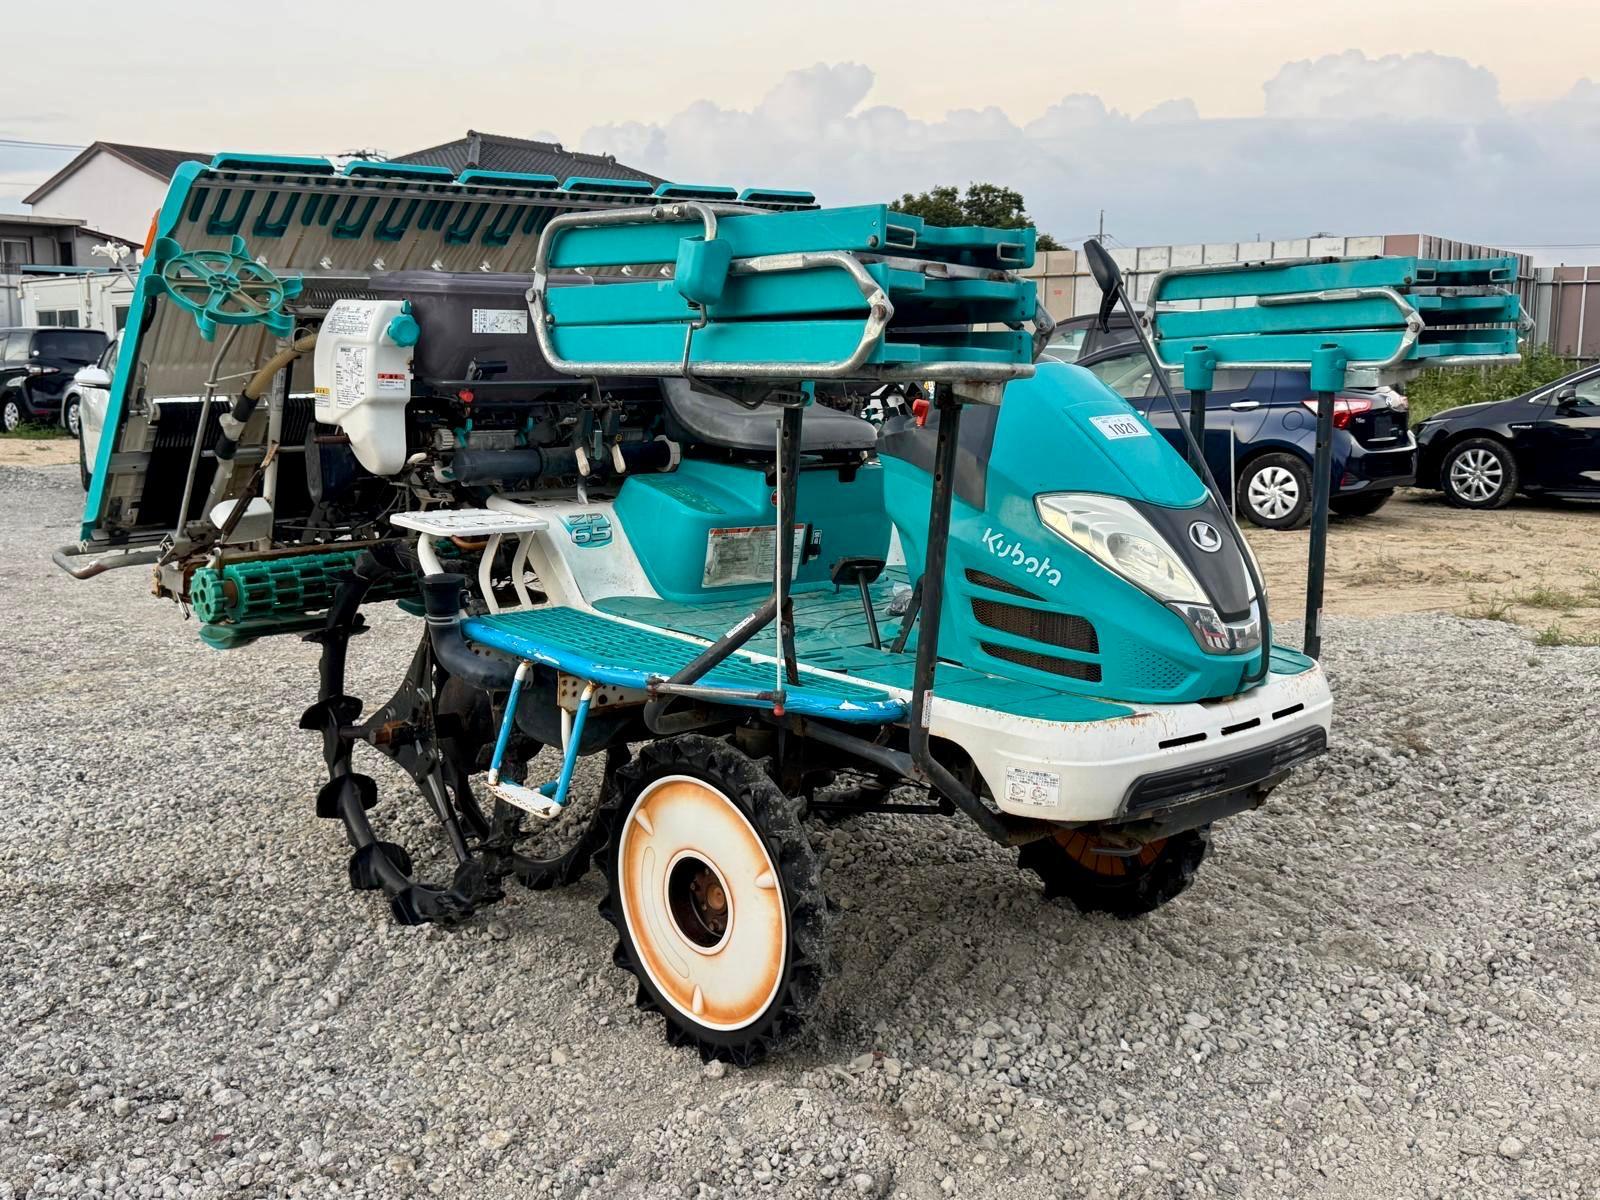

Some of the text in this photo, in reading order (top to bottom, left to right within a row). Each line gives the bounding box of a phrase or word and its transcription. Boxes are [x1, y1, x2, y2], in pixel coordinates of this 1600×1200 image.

[1108, 422, 1139, 435] 1020
[568, 512, 604, 525] ZP
[571, 524, 613, 544] 65
[982, 527, 1062, 587] Kubota
